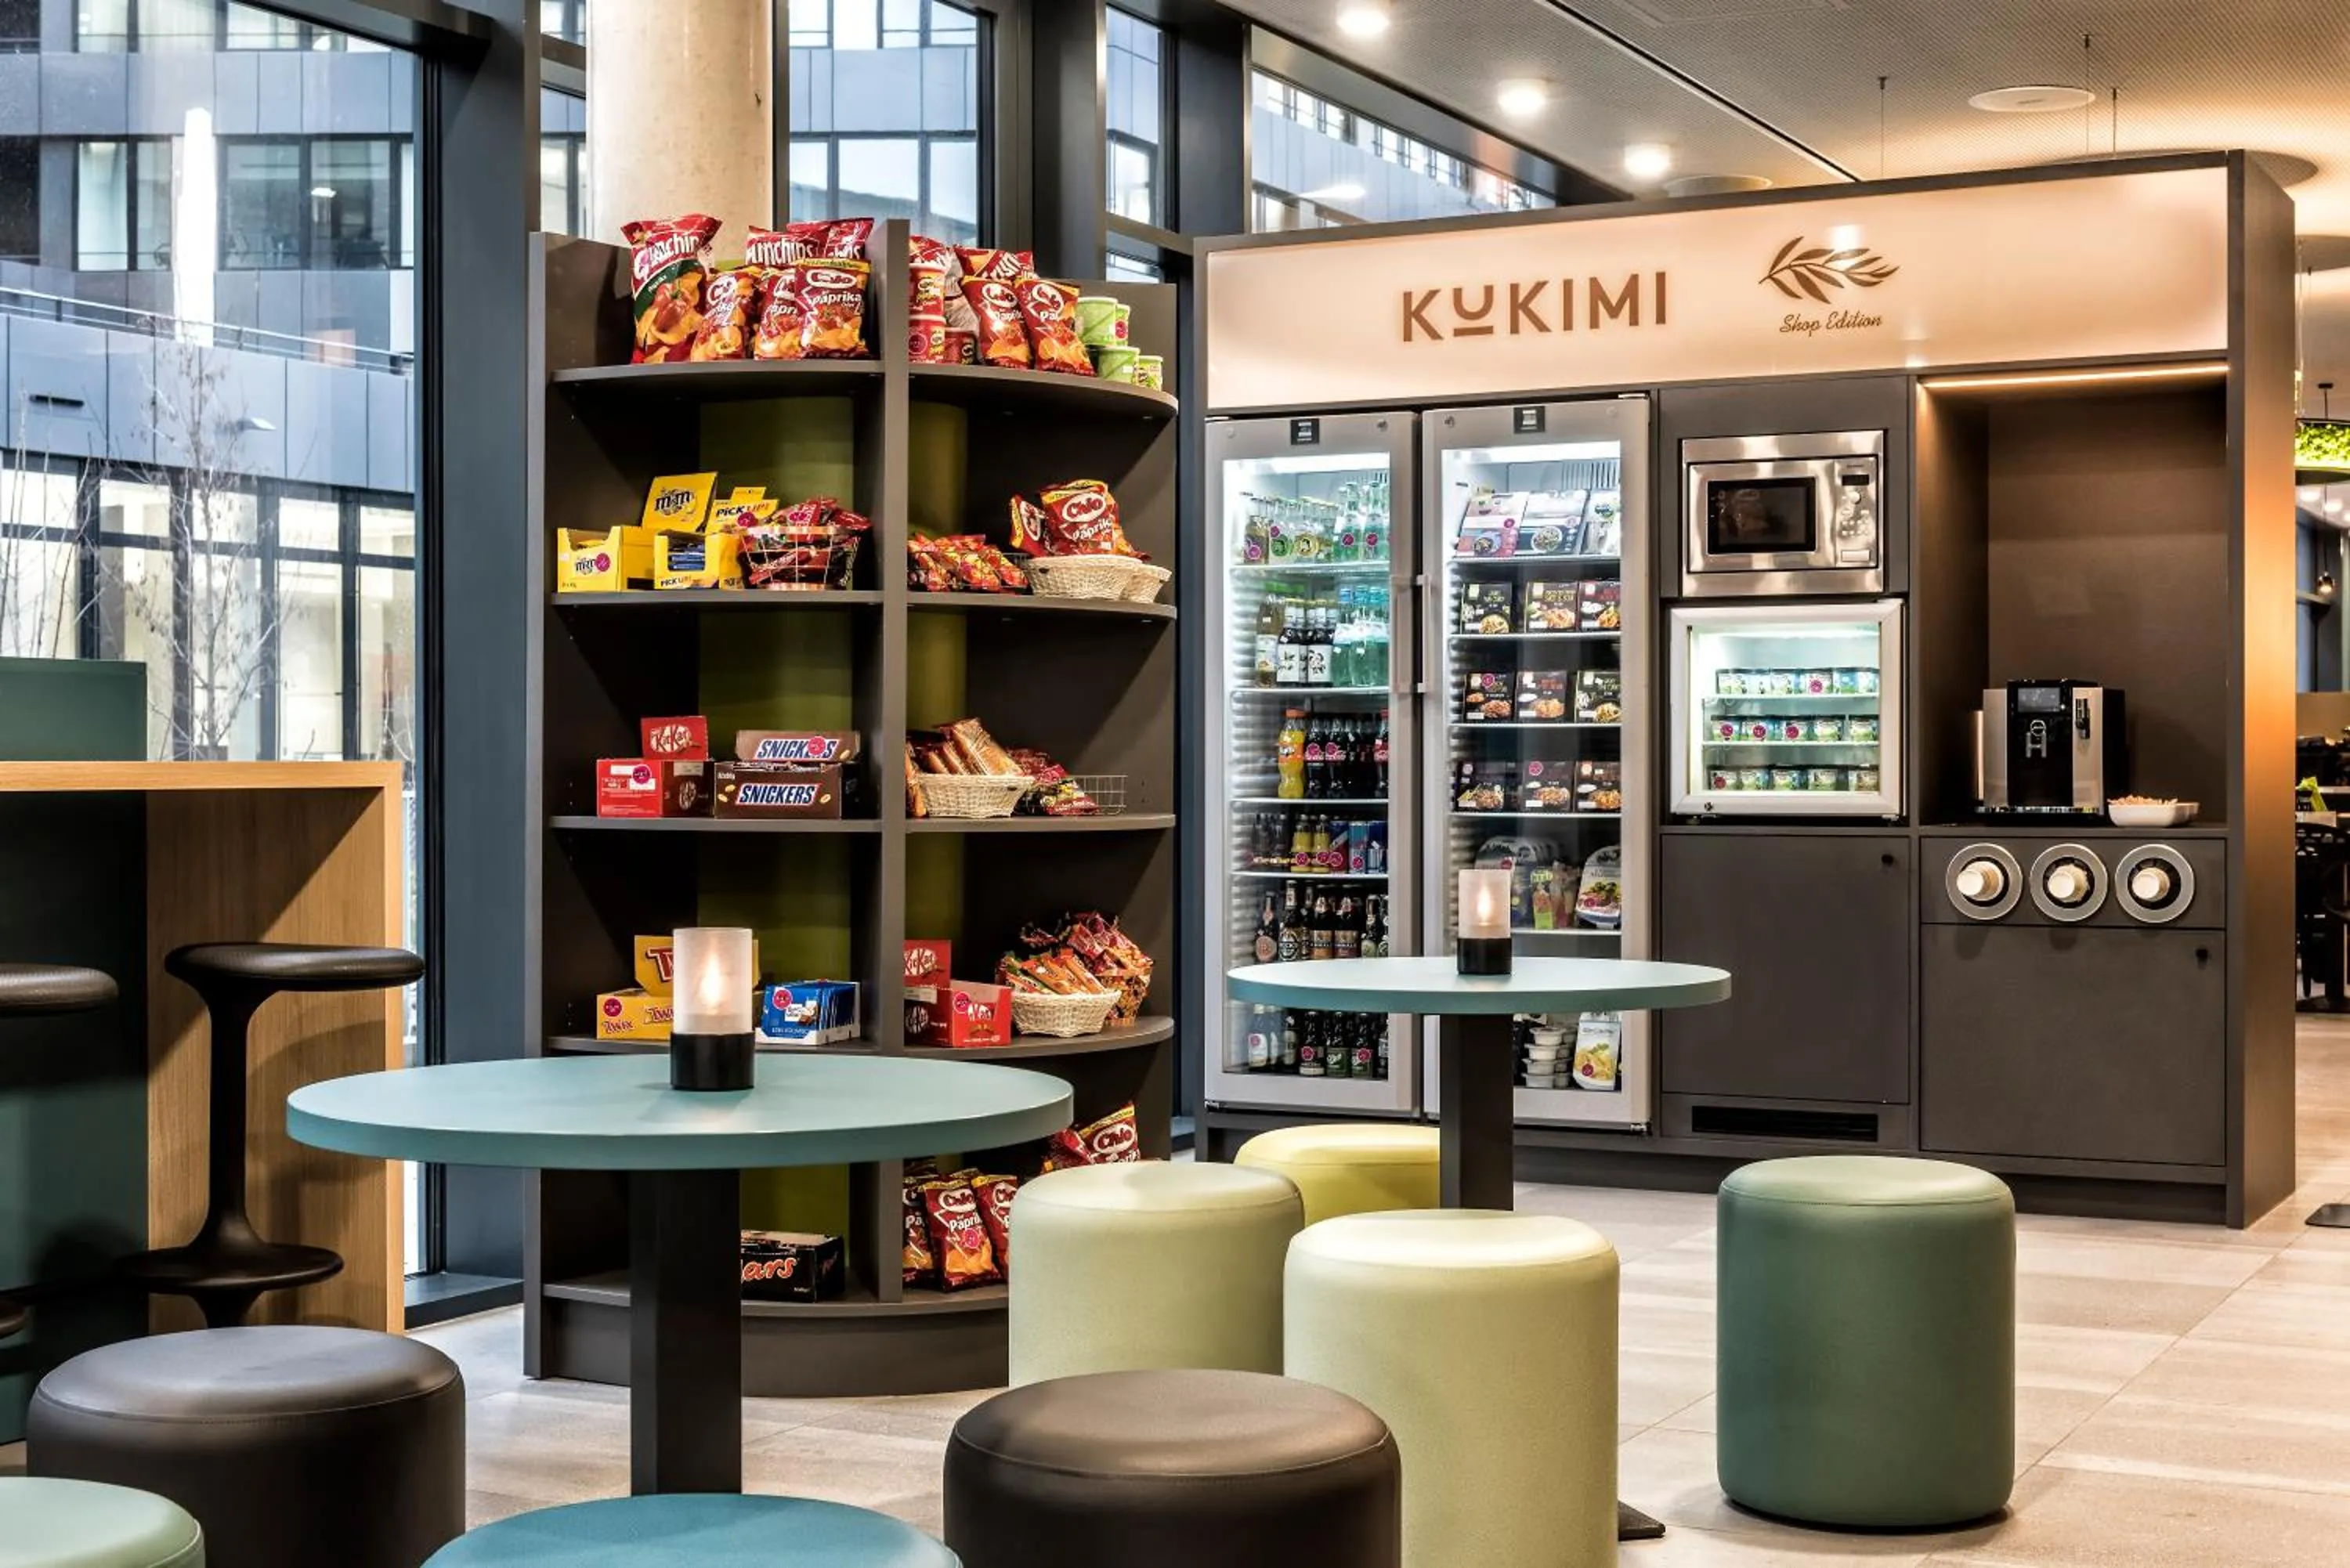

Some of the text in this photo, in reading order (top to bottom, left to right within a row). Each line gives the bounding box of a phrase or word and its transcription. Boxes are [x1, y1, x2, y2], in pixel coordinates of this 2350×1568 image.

[1403, 271, 1666, 342] KUKIMI
[1779, 310, 1882, 337] Shop Edition
[1066, 497, 1104, 519] Chio
[757, 739, 838, 758] SNICKS
[739, 785, 816, 804] SNICKERS
[602, 1020, 633, 1035] Twix
[1097, 1126, 1132, 1150] Chio
[942, 1191, 975, 1209] Chio
[742, 1257, 797, 1281] ars
